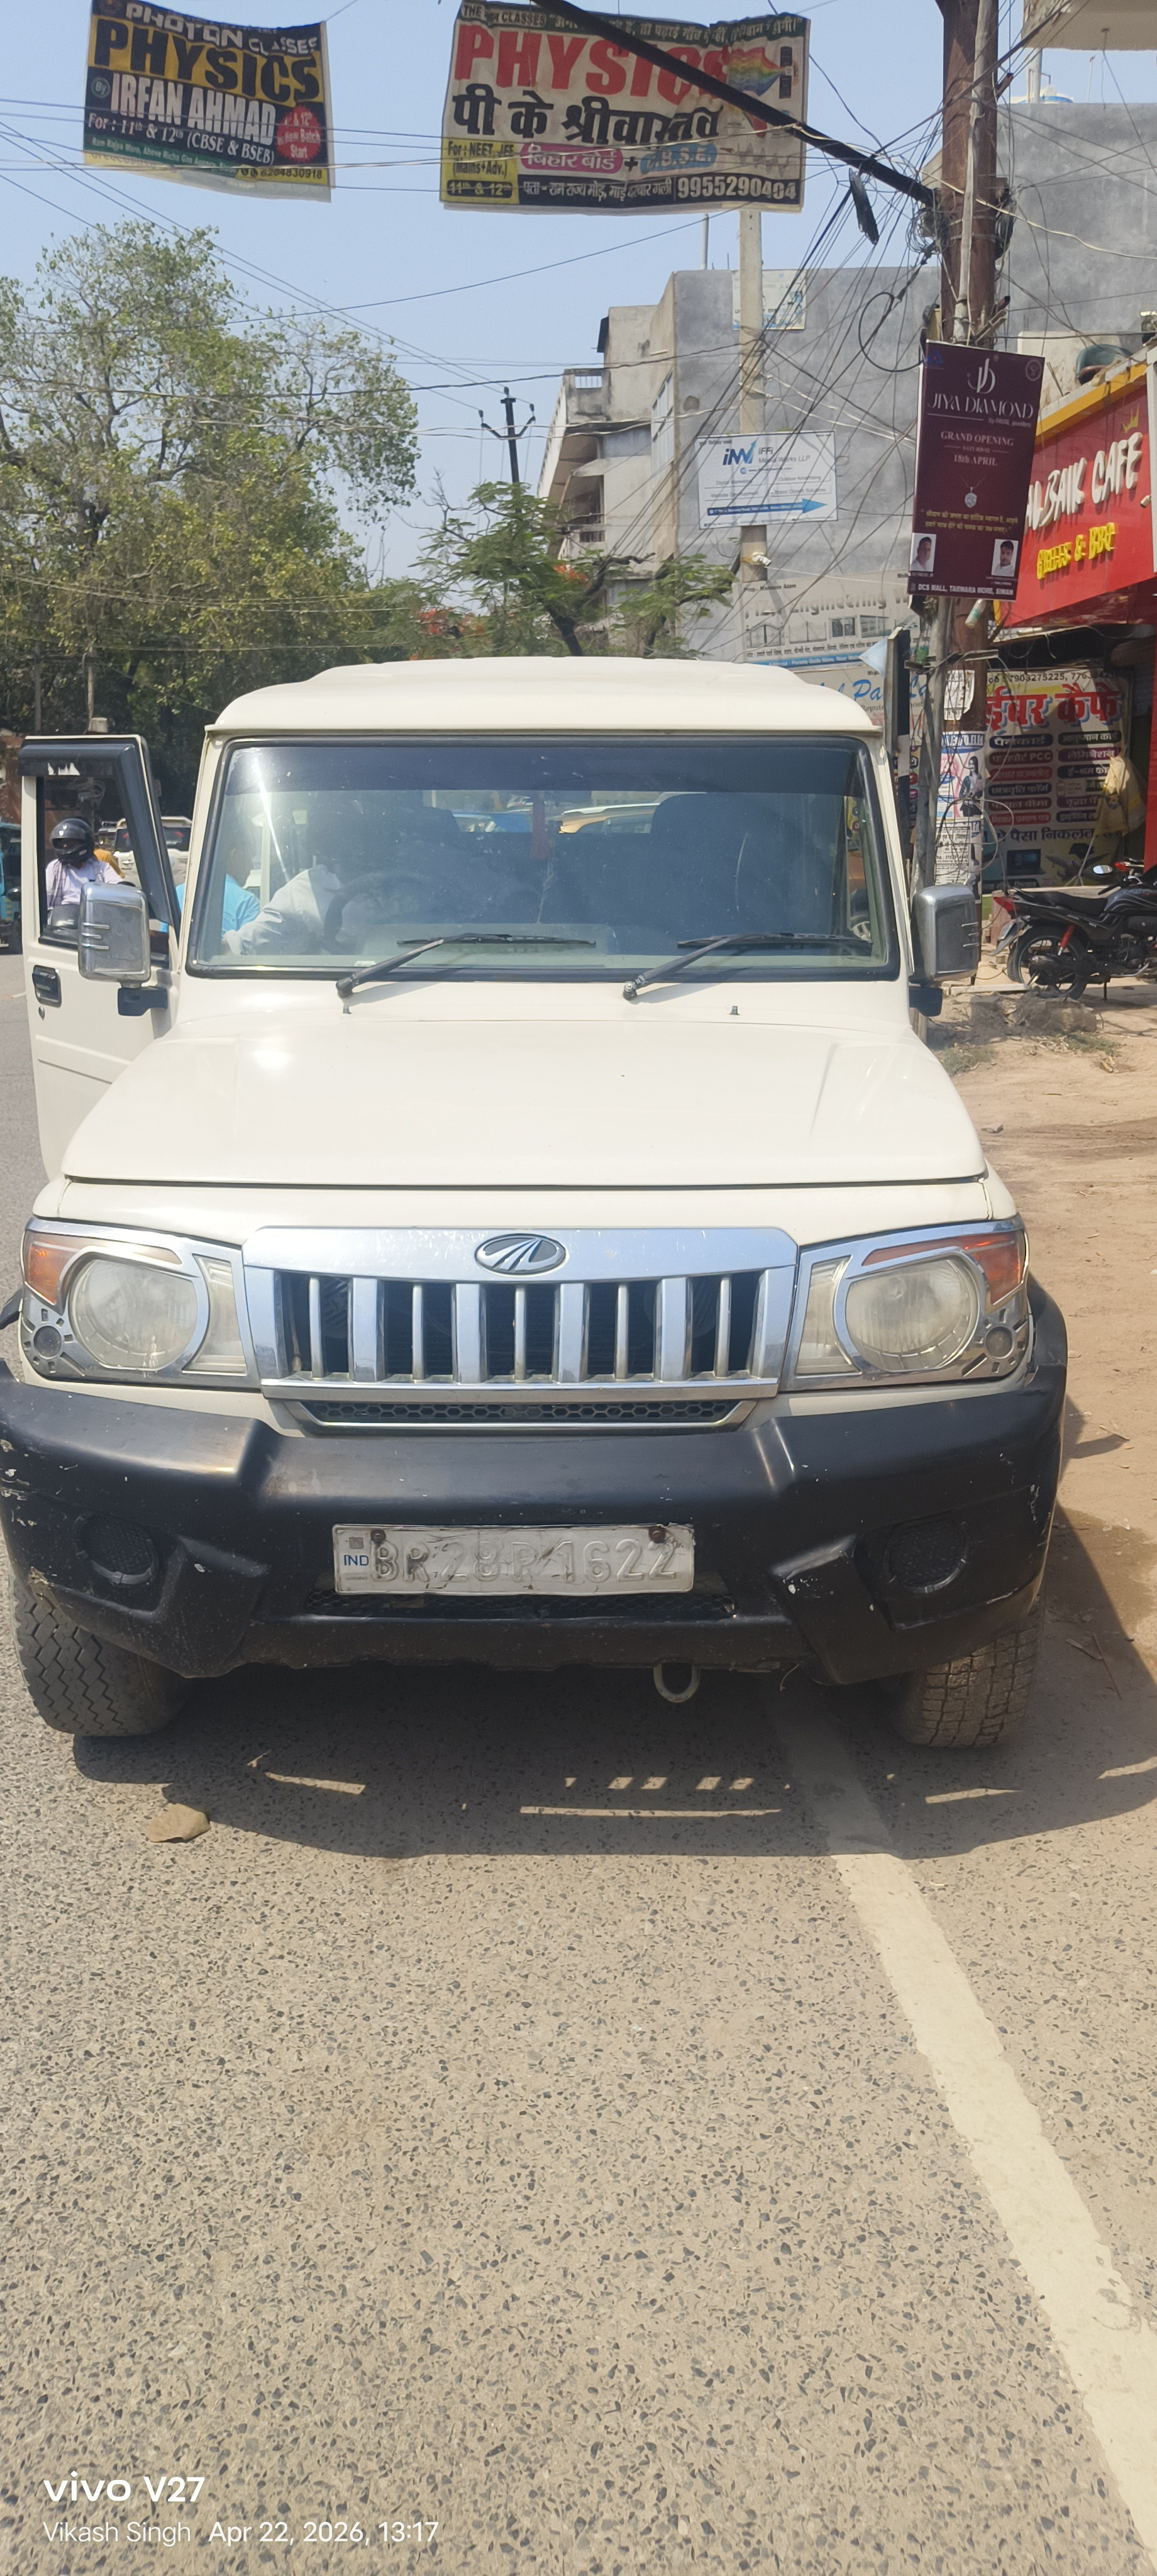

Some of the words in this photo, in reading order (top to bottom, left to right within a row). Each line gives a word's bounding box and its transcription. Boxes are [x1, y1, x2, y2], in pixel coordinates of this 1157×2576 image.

[126, 3, 243, 48] PHOTON
[463, 4, 482, 18] THE
[501, 11, 546, 26] CLASSES
[94, 19, 320, 103] PHYSICS
[454, 24, 731, 106] PHYSICS
[111, 73, 184, 125] IRFAN
[187, 87, 277, 146] AHMAD
[452, 83, 503, 136] पी
[507, 90, 554, 138] के
[561, 95, 725, 149] श्रीवास्तव
[120, 119, 143, 136] 11th
[146, 123, 158, 139] &
[162, 126, 184, 143] 12th
[187, 130, 224, 154] (CBSE
[227, 140, 239, 156] &
[241, 142, 275, 166] BSEB)
[300, 128, 321, 144] Batch
[290, 143, 308, 159] Start
[527, 143, 578, 169] बिहार
[581, 149, 618, 170] बोर्ड
[473, 182, 485, 196] &
[523, 181, 541, 196] पता
[549, 182, 565, 196] राम
[566, 182, 586, 197] राज्य
[652, 177, 672, 196] गली
[677, 175, 797, 200] 9955290404
[927, 392, 960, 411] JIYA
[965, 397, 1034, 419] DIAMOND
[940, 430, 973, 443] GRAND
[975, 434, 1014, 447] OPENING
[954, 454, 970, 464] 18th
[971, 456, 999, 467] APRIL
[1091, 431, 1143, 504] CAFE
[1074, 534, 1087, 562] &
[949, 585, 977, 594] TARWARA
[1054, 682, 1121, 724] कैफे
[1029, 752, 1051, 762] PCC
[1010, 829, 1038, 841] पैसा
[343, 1554, 370, 1567] IND
